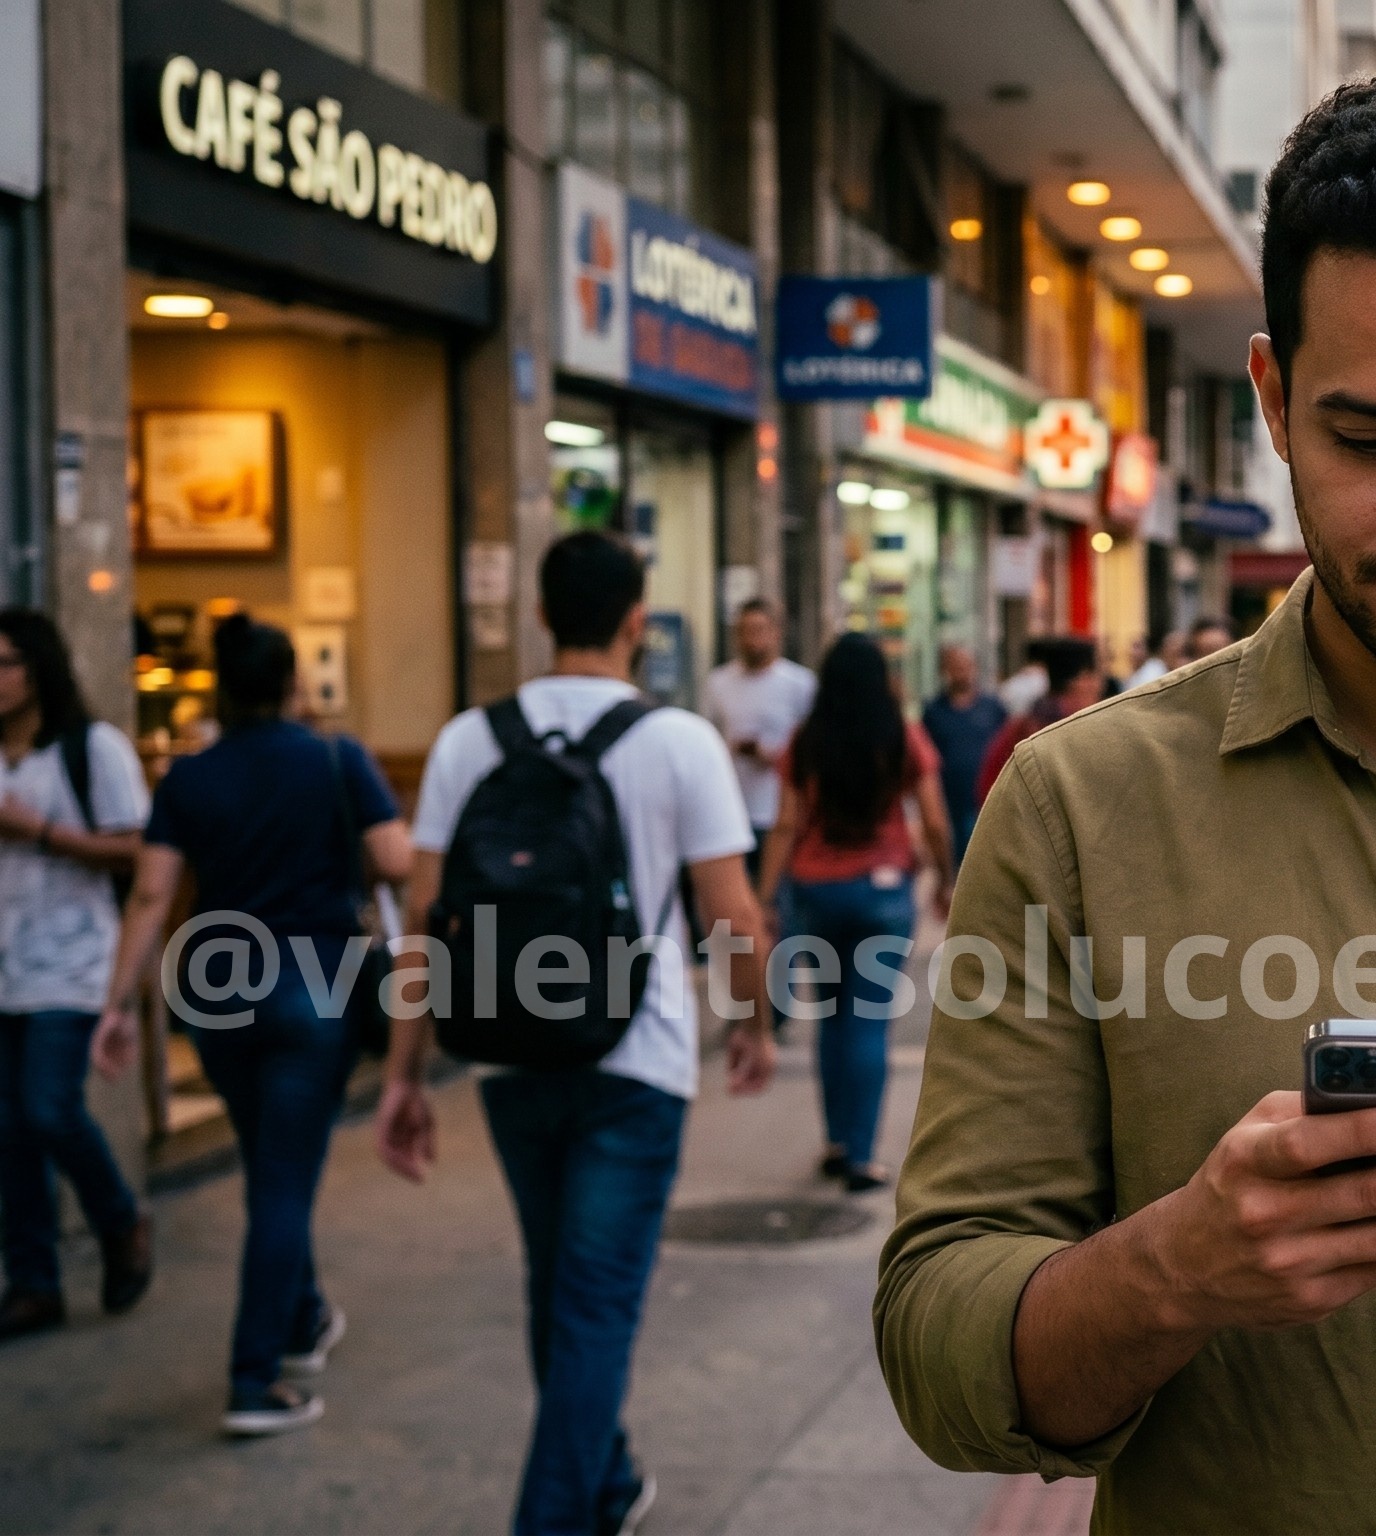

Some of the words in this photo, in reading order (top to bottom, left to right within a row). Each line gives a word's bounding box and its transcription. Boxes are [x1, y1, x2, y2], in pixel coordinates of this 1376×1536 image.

[160, 55, 284, 187] CAFÉ
[287, 97, 376, 219] SÃO
[377, 143, 498, 264] PEDRO
[631, 230, 757, 333] LOTÉRICA
